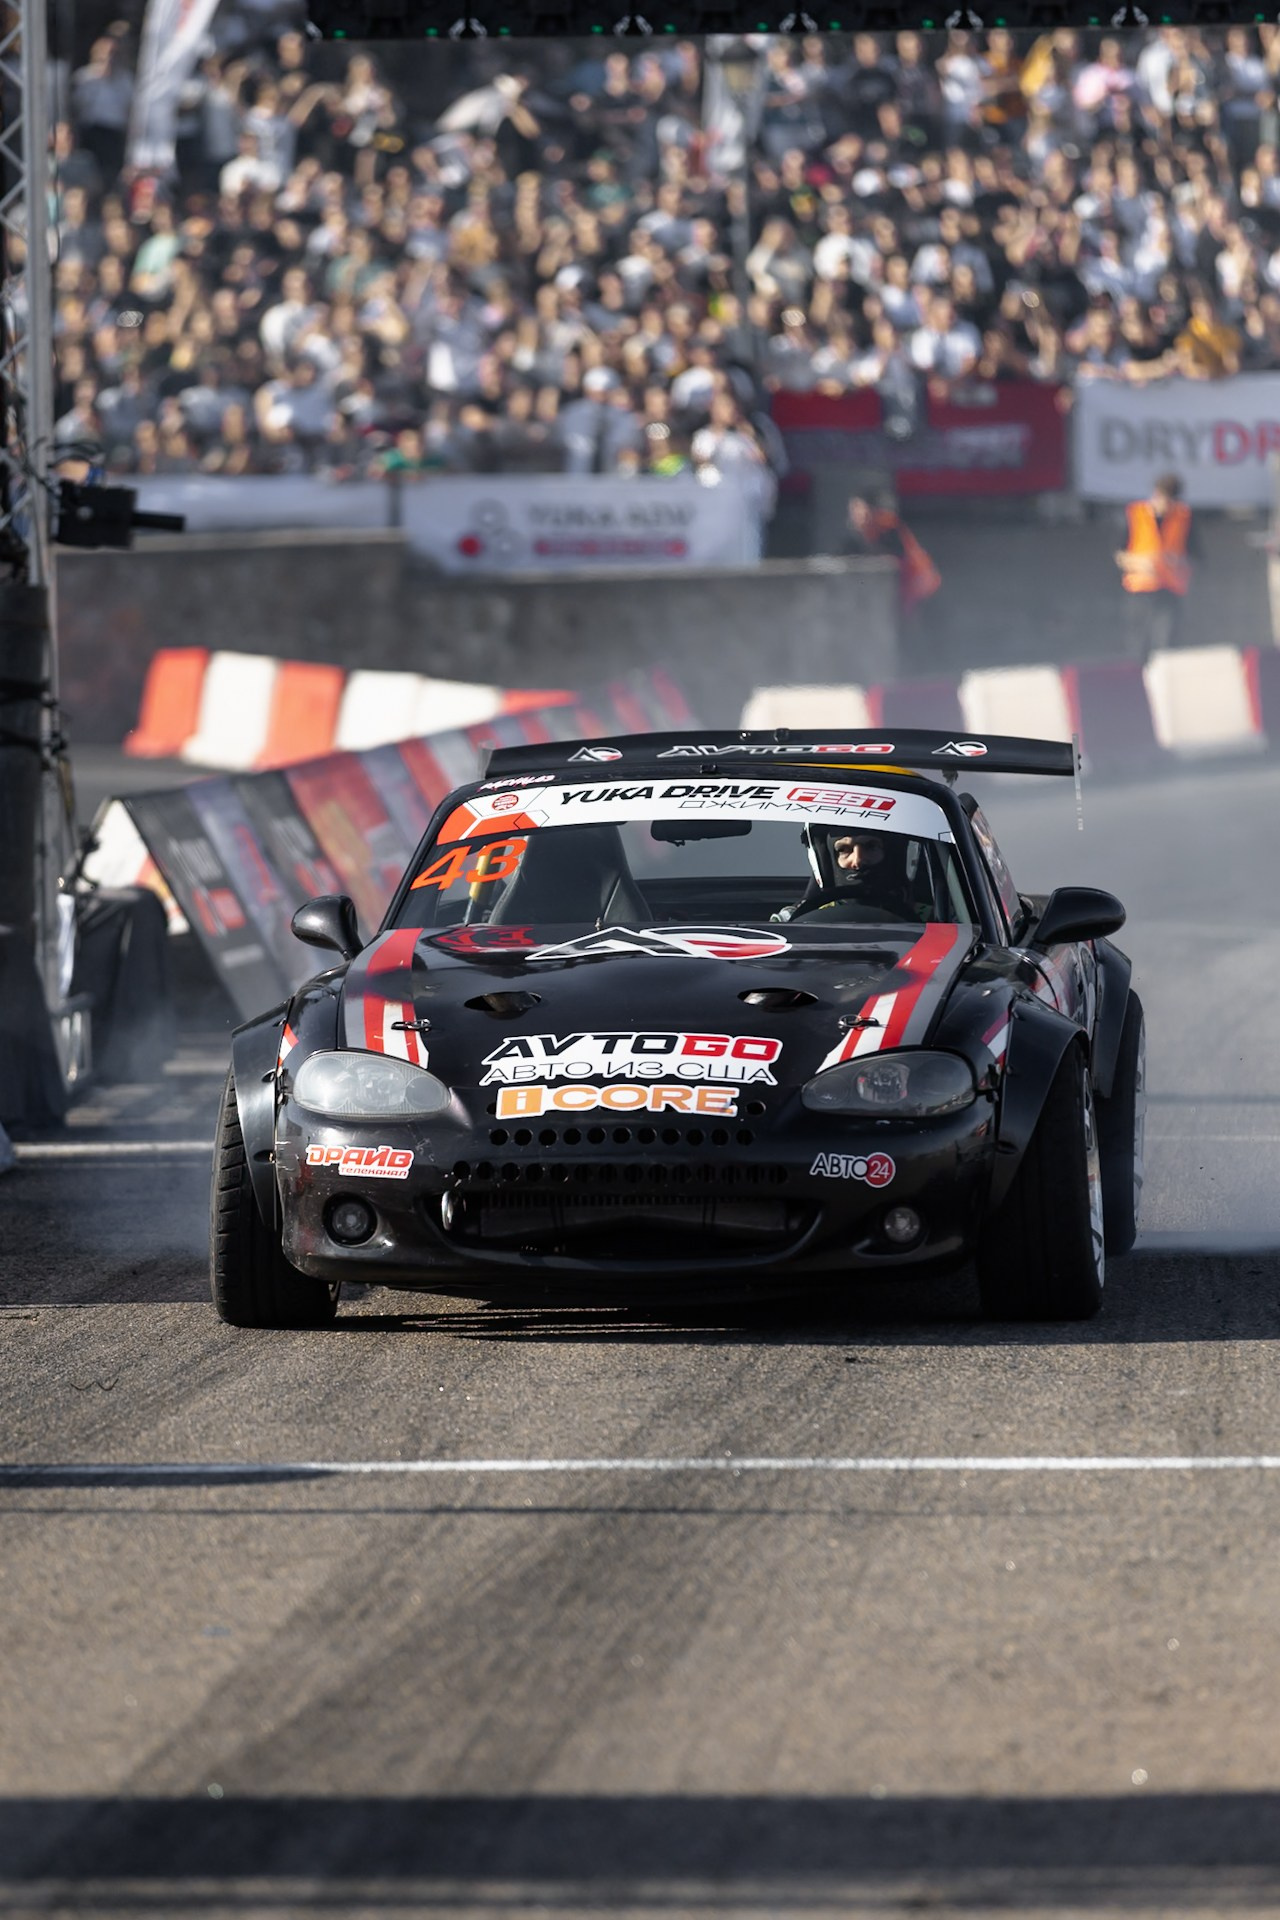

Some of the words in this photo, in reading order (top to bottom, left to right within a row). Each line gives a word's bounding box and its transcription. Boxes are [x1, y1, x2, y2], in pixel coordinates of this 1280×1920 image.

[561, 786, 654, 806] YUKA
[659, 784, 780, 799] DRIVE
[788, 787, 897, 811] FEST
[677, 800, 891, 821] ДЖИМХАНА
[409, 838, 528, 892] 43
[488, 1033, 782, 1062] AVTOGO
[485, 1060, 595, 1083] АВТО
[605, 1061, 664, 1077] ИЗ
[676, 1062, 776, 1081] США
[309, 1146, 412, 1168] ДРАЙВ
